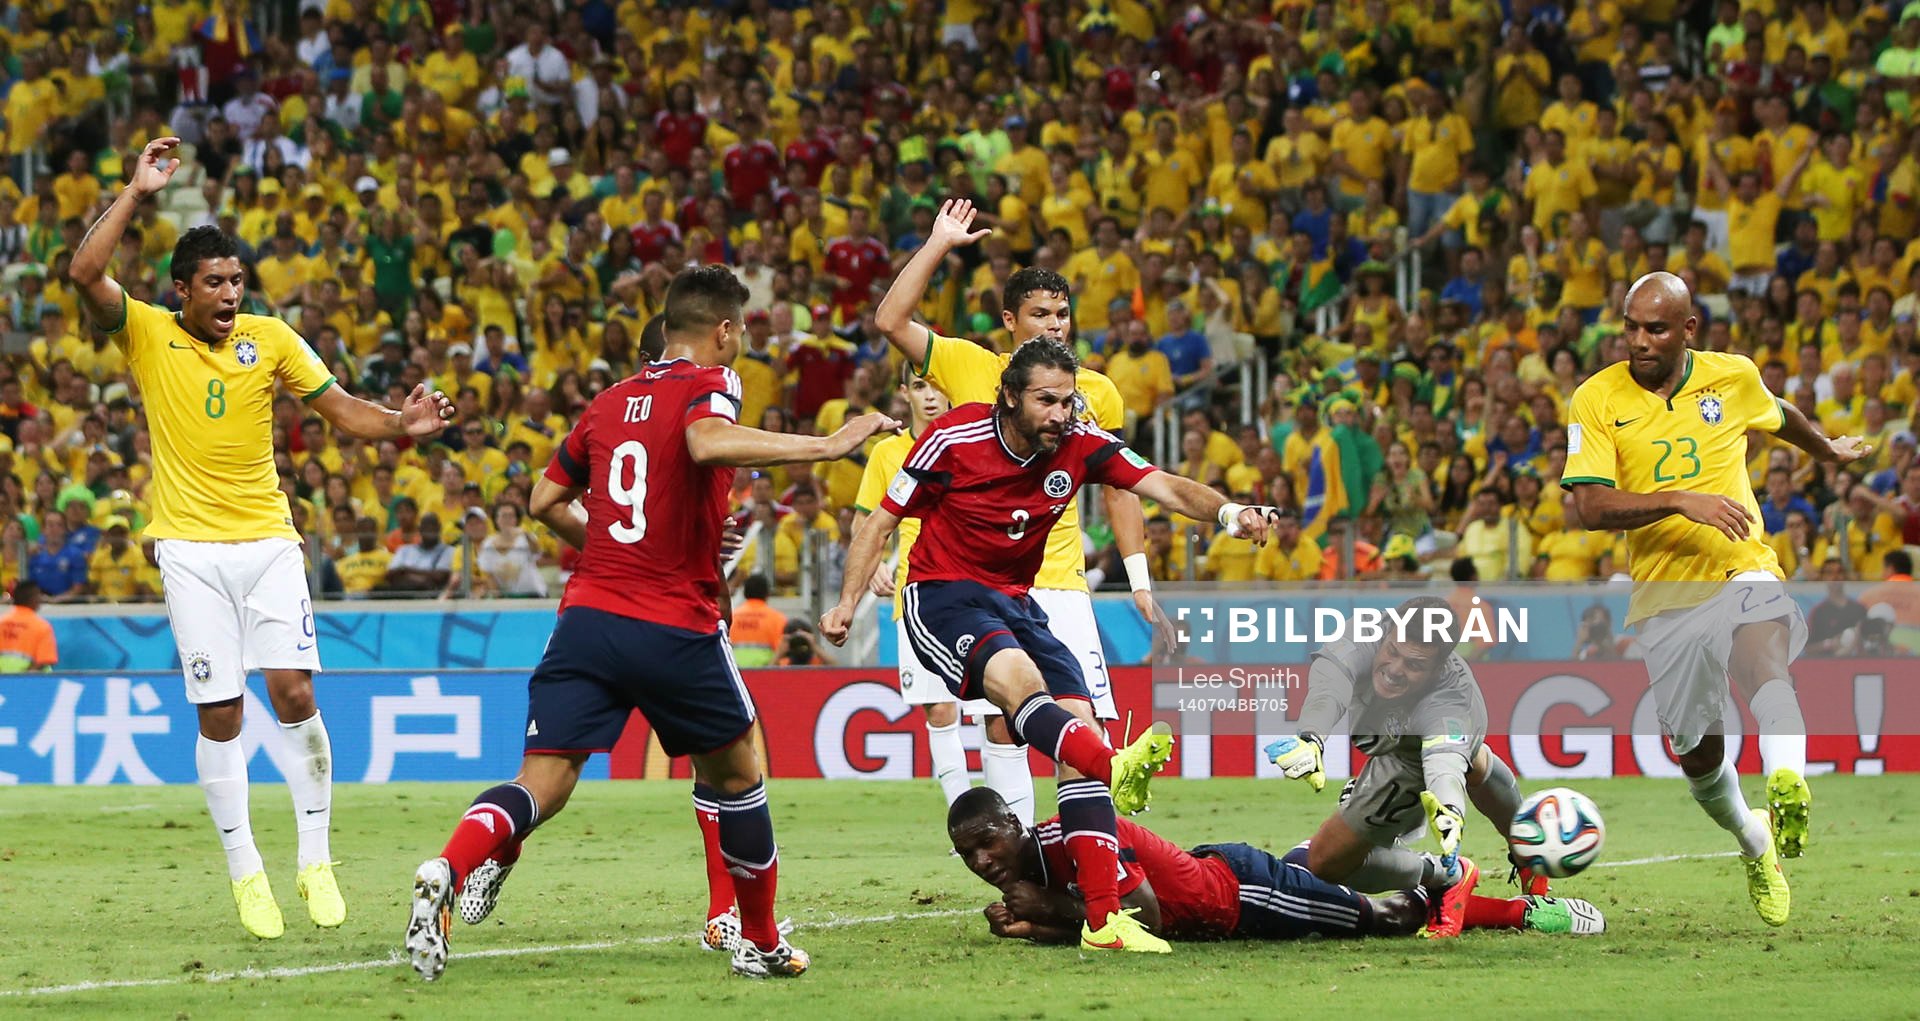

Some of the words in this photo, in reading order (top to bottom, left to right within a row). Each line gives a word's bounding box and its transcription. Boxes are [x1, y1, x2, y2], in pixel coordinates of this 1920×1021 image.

[204, 378, 226, 419] 8
[622, 394, 653, 424] TEO
[1651, 436, 1702, 483] 23
[607, 440, 649, 545] 9
[1007, 509, 1030, 541] 3
[300, 598, 314, 638] 8
[1089, 651, 1107, 688] 3
[1375, 781, 1421, 824] 12
